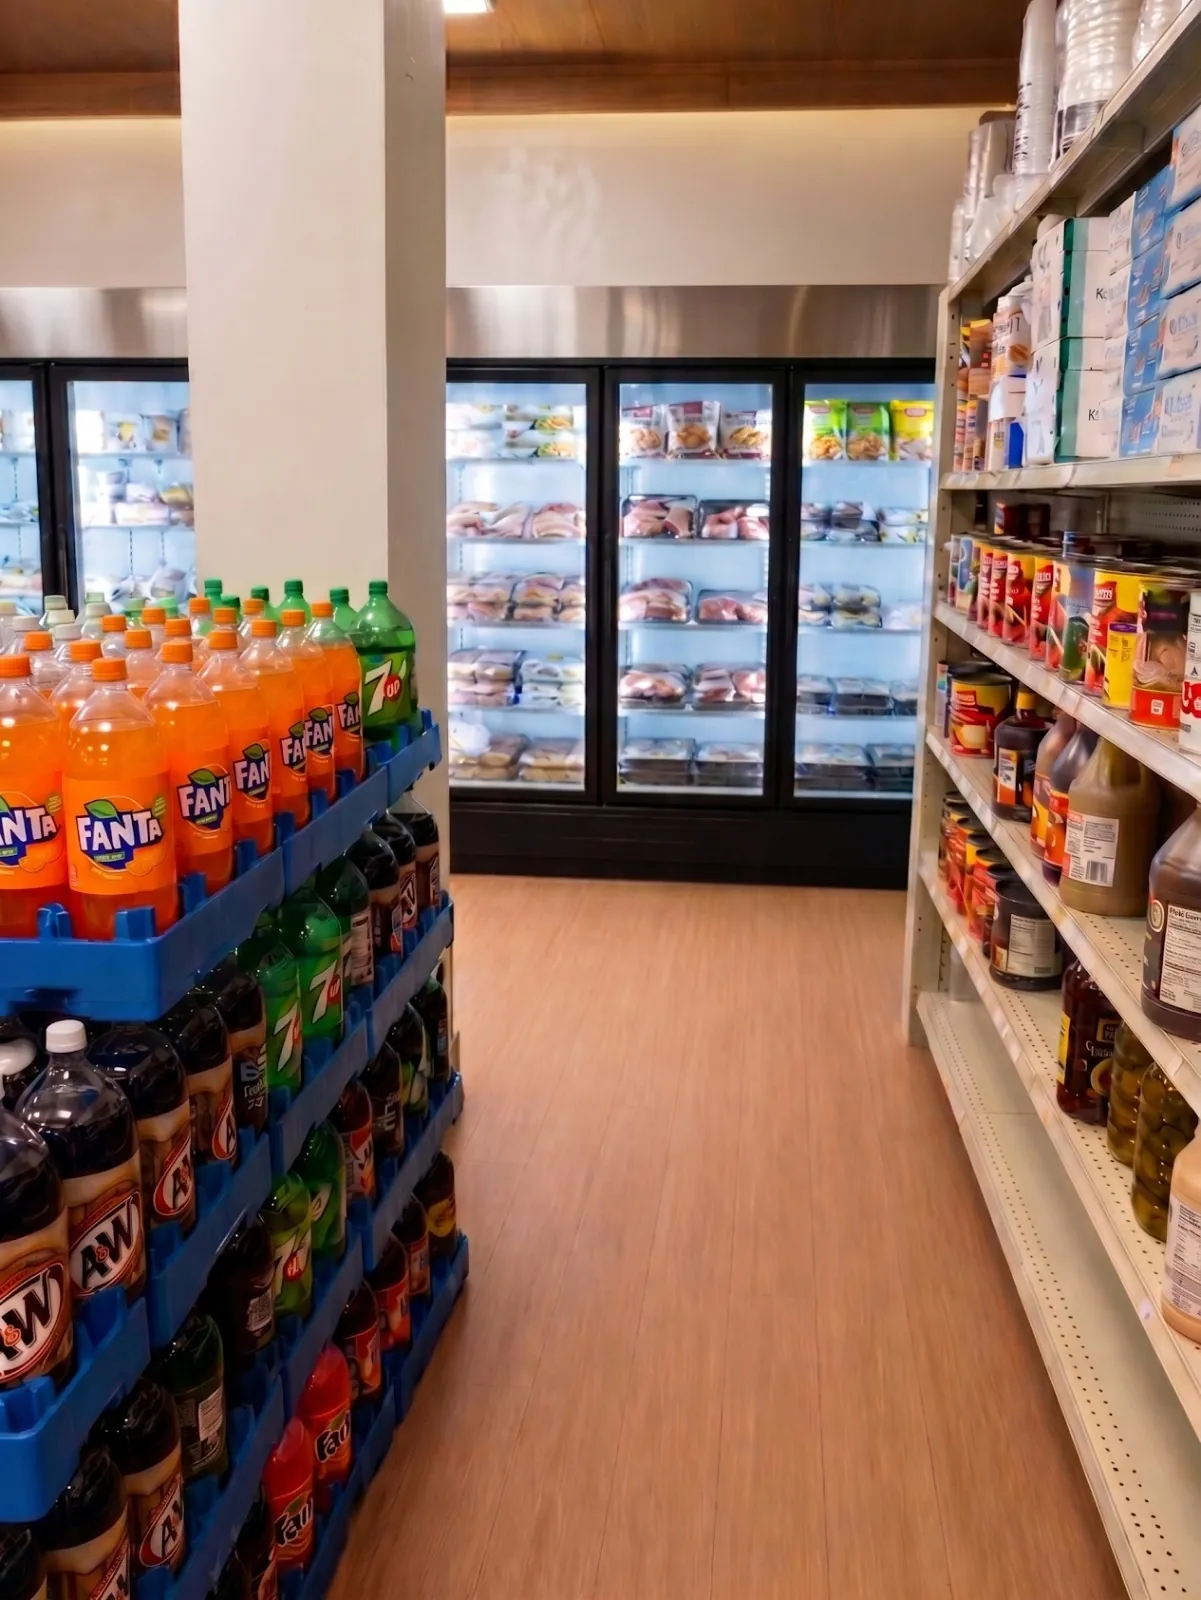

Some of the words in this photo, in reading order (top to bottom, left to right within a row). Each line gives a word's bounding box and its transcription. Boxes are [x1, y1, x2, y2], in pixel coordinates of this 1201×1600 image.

[0, 807, 57, 847] NTA
[77, 810, 162, 851] FANTA
[80, 1201, 133, 1290] A&W
